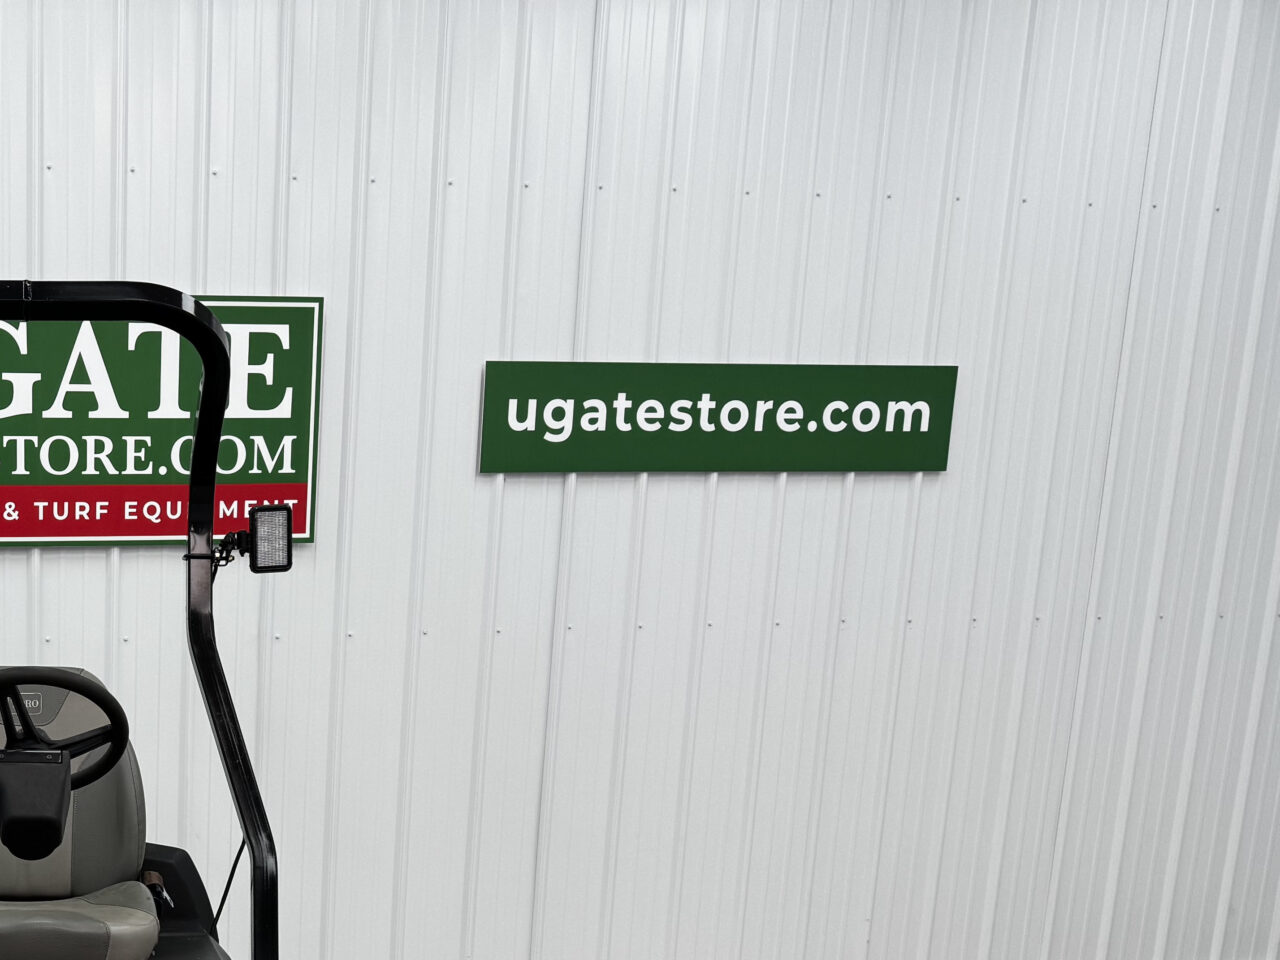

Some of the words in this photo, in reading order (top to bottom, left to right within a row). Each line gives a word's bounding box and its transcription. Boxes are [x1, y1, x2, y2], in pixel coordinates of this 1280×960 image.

[507, 392, 931, 442] ugatestore.com
[2, 501, 20, 520] &
[33, 500, 110, 521] TURF
